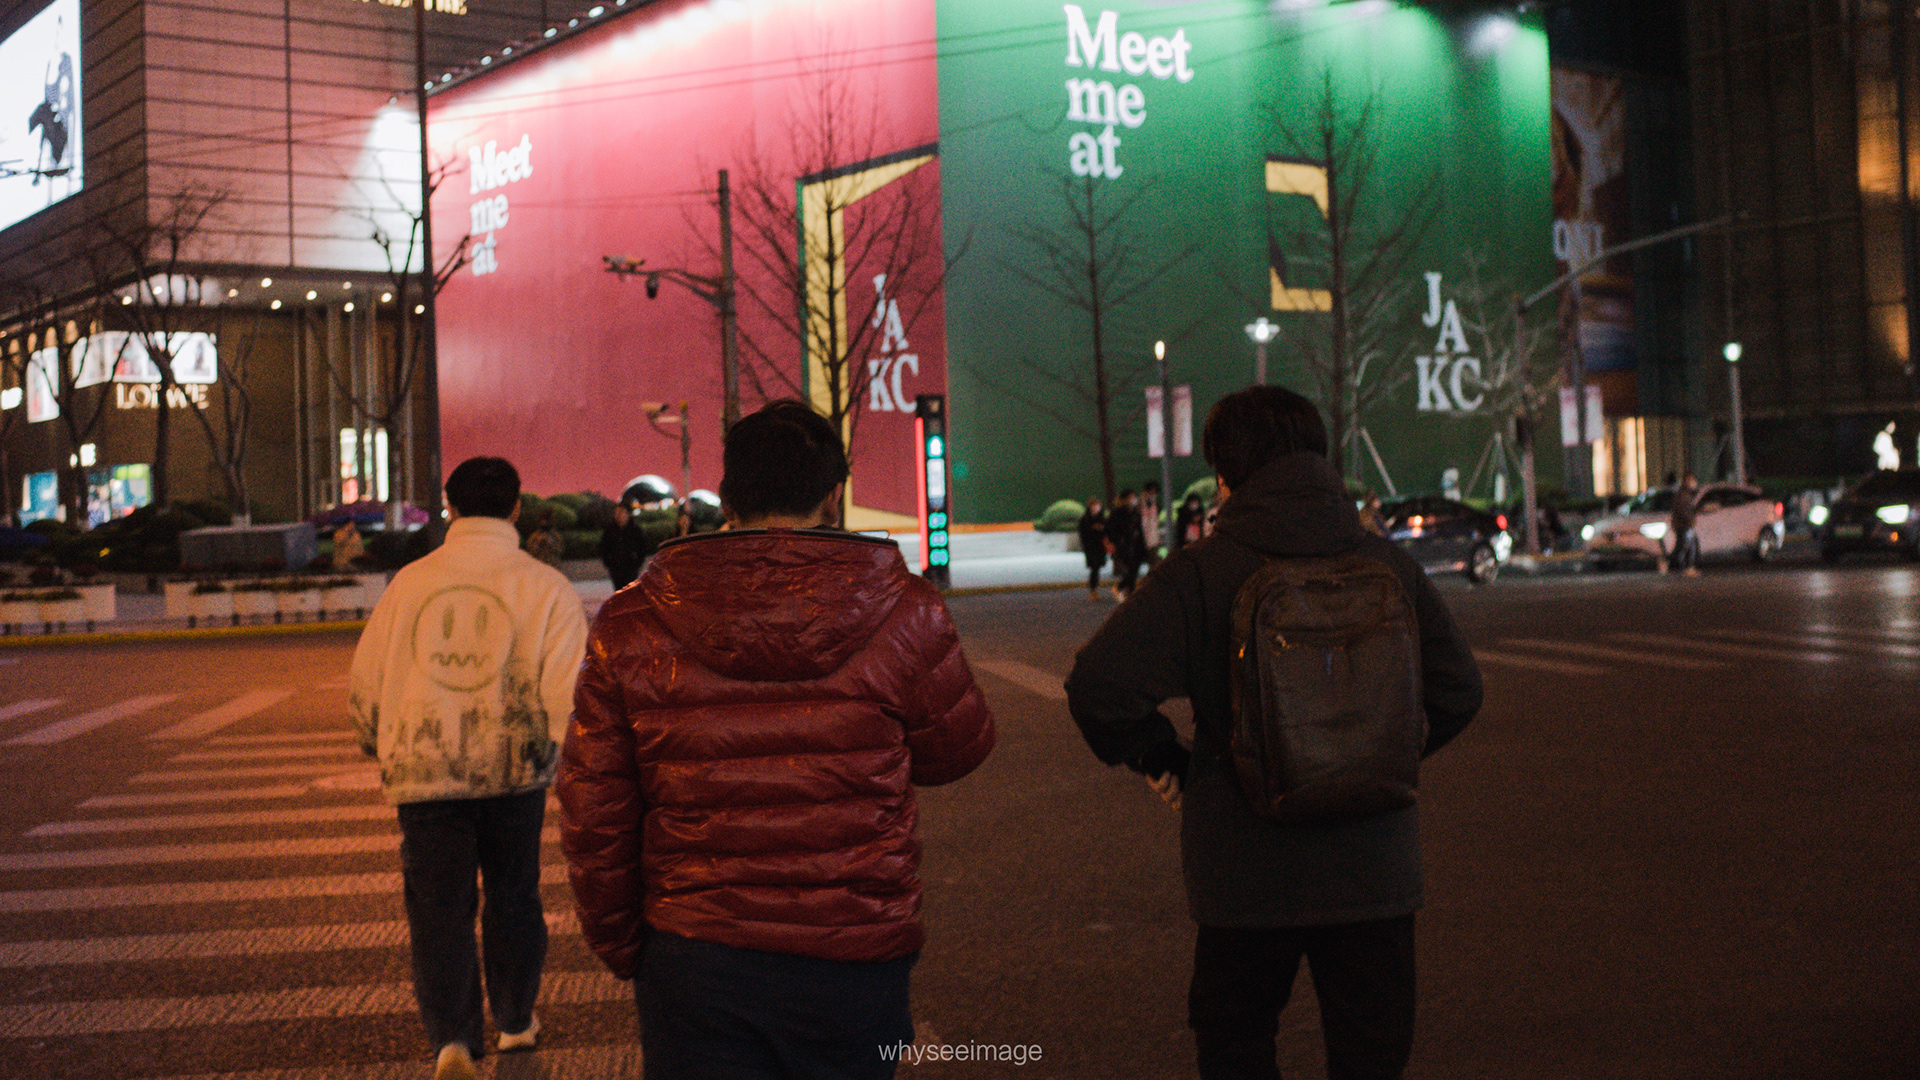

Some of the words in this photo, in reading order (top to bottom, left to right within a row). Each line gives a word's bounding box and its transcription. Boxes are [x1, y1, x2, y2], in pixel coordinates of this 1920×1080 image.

[1063, 3, 1194, 83] Meet
[1065, 77, 1147, 128] me
[468, 133, 533, 195] Meet
[1069, 124, 1123, 180] at
[470, 194, 509, 236] me
[472, 231, 498, 276] at
[868, 353, 919, 414] KC
[1415, 356, 1484, 411] KC
